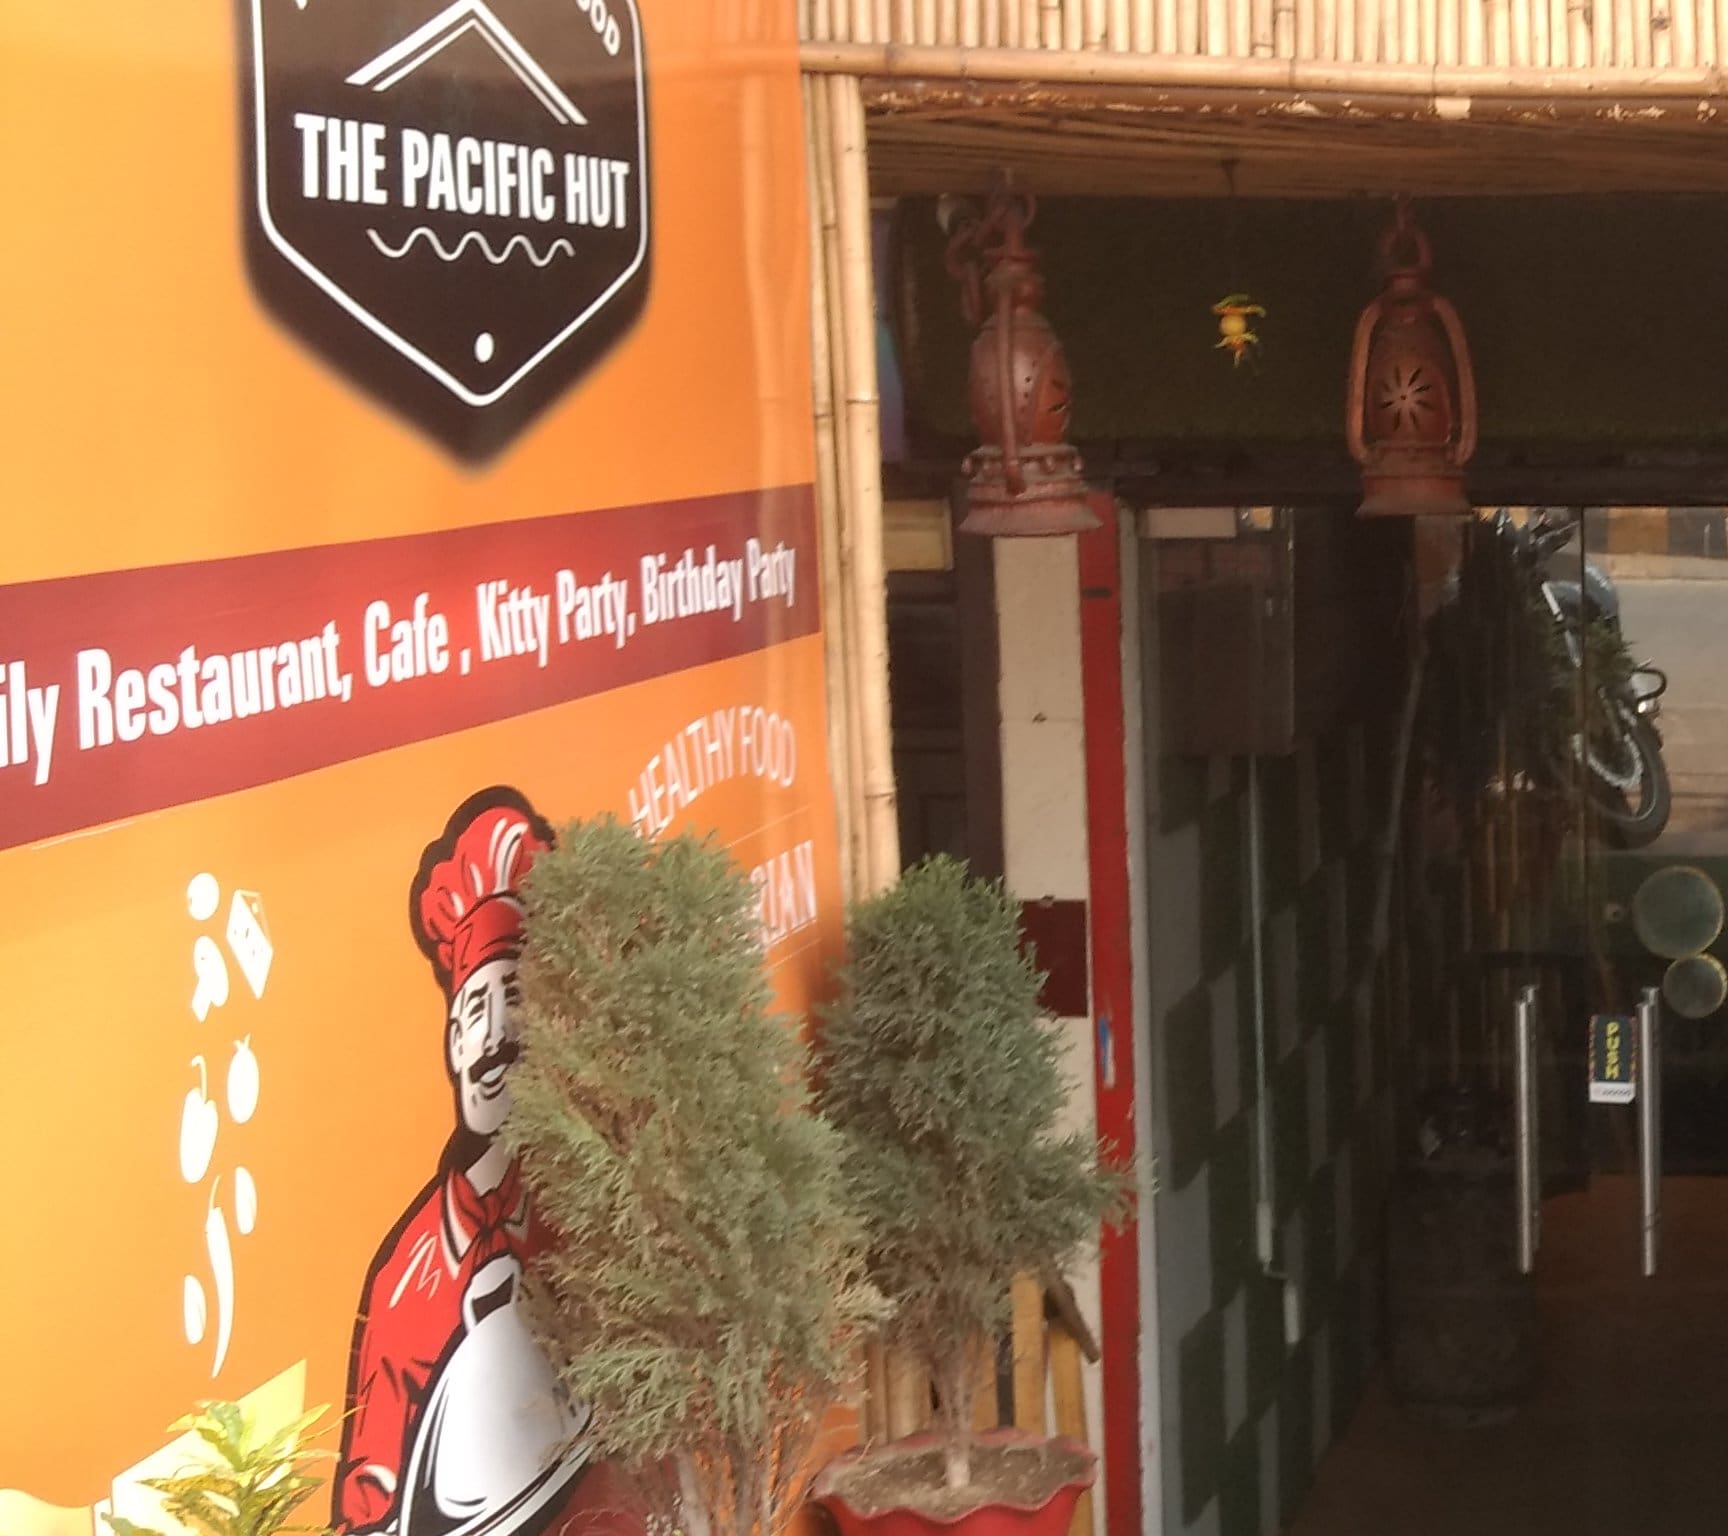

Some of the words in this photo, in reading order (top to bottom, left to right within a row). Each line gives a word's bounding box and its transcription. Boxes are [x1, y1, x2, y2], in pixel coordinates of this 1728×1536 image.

[294, 112, 388, 206] THE
[401, 127, 556, 223] PACIFIC
[563, 152, 631, 230] HUT
[77, 618, 353, 751] Restaurant,
[364, 592, 450, 688] Cafe
[476, 579, 550, 669] Kitty
[555, 568, 637, 650] Party,
[641, 543, 744, 623] Birthday
[746, 537, 796, 608] Party
[628, 706, 737, 842] HEALTHY
[739, 704, 797, 789] FOOD
[1604, 1020, 1621, 1081] PUSH
